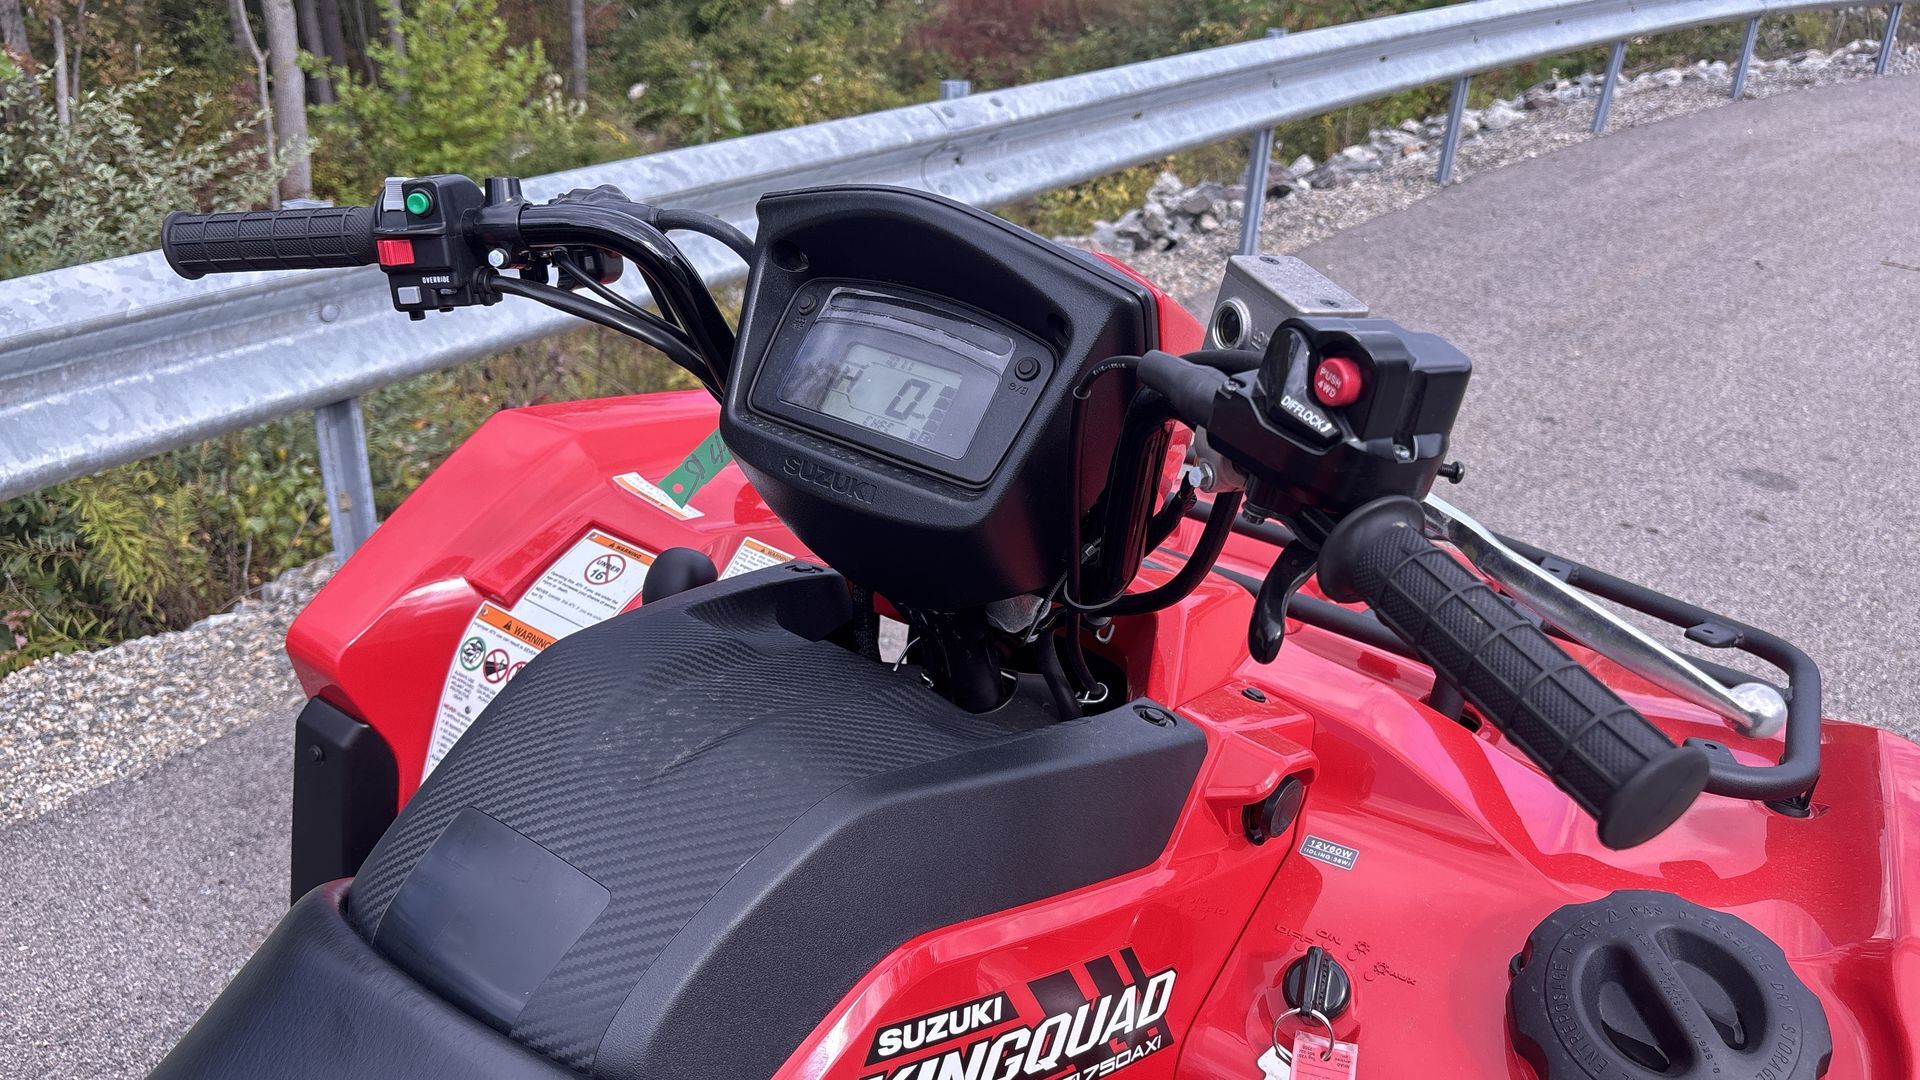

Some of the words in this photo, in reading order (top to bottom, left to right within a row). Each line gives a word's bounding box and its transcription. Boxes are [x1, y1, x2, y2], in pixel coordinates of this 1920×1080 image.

[422, 275, 450, 284] OVERRIDE
[1320, 367, 1341, 387] PUSH
[884, 378, 931, 420] 0
[1317, 380, 1337, 398] 4WD
[1280, 394, 1324, 431] DIFFLOCK
[782, 456, 878, 504] SUZUKI
[616, 544, 642, 559] WARNING
[590, 568, 606, 581] 16
[1310, 840, 1353, 858] 12V60W
[1274, 924, 1314, 945] OFF
[1315, 928, 1341, 946] ON
[1771, 982, 1794, 1013] DRY
[878, 996, 1002, 1056] SUZUKI
